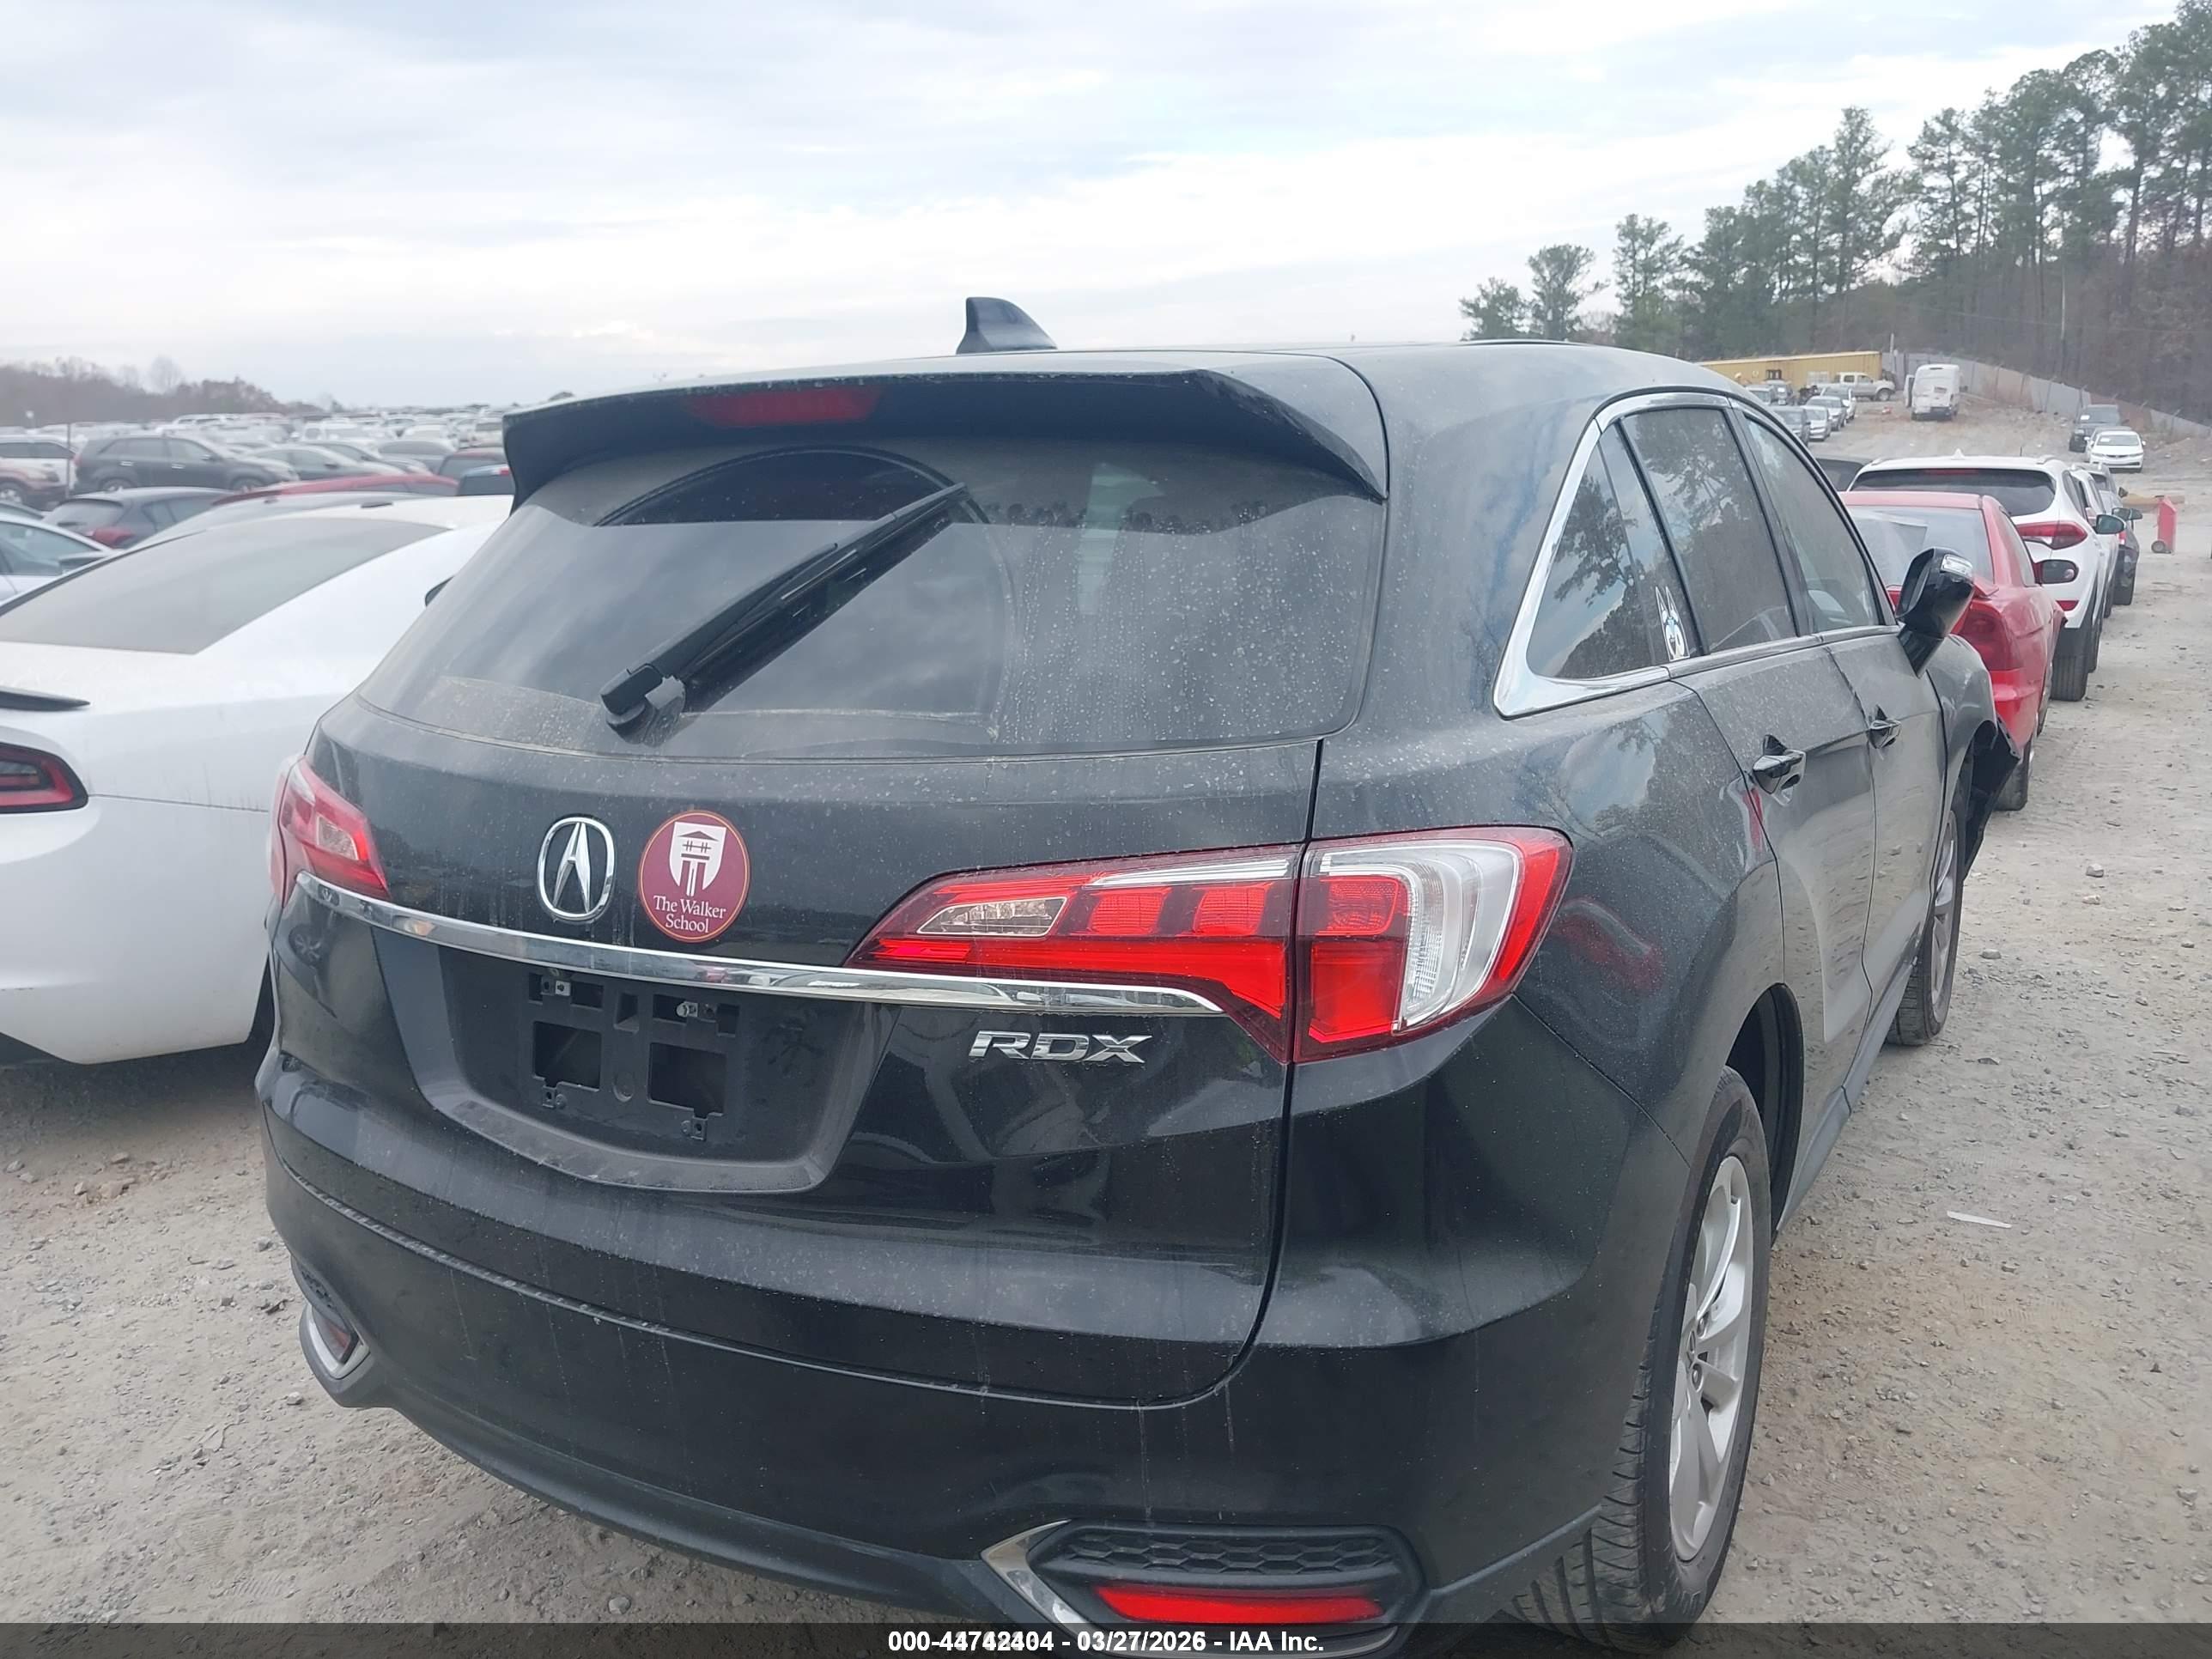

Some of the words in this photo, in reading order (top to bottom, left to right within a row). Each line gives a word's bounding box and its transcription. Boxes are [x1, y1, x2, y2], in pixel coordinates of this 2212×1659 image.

[653, 895, 678, 912] The
[680, 898, 726, 919] Walker
[665, 913, 708, 933] School
[969, 1030, 1152, 1063] RDX
